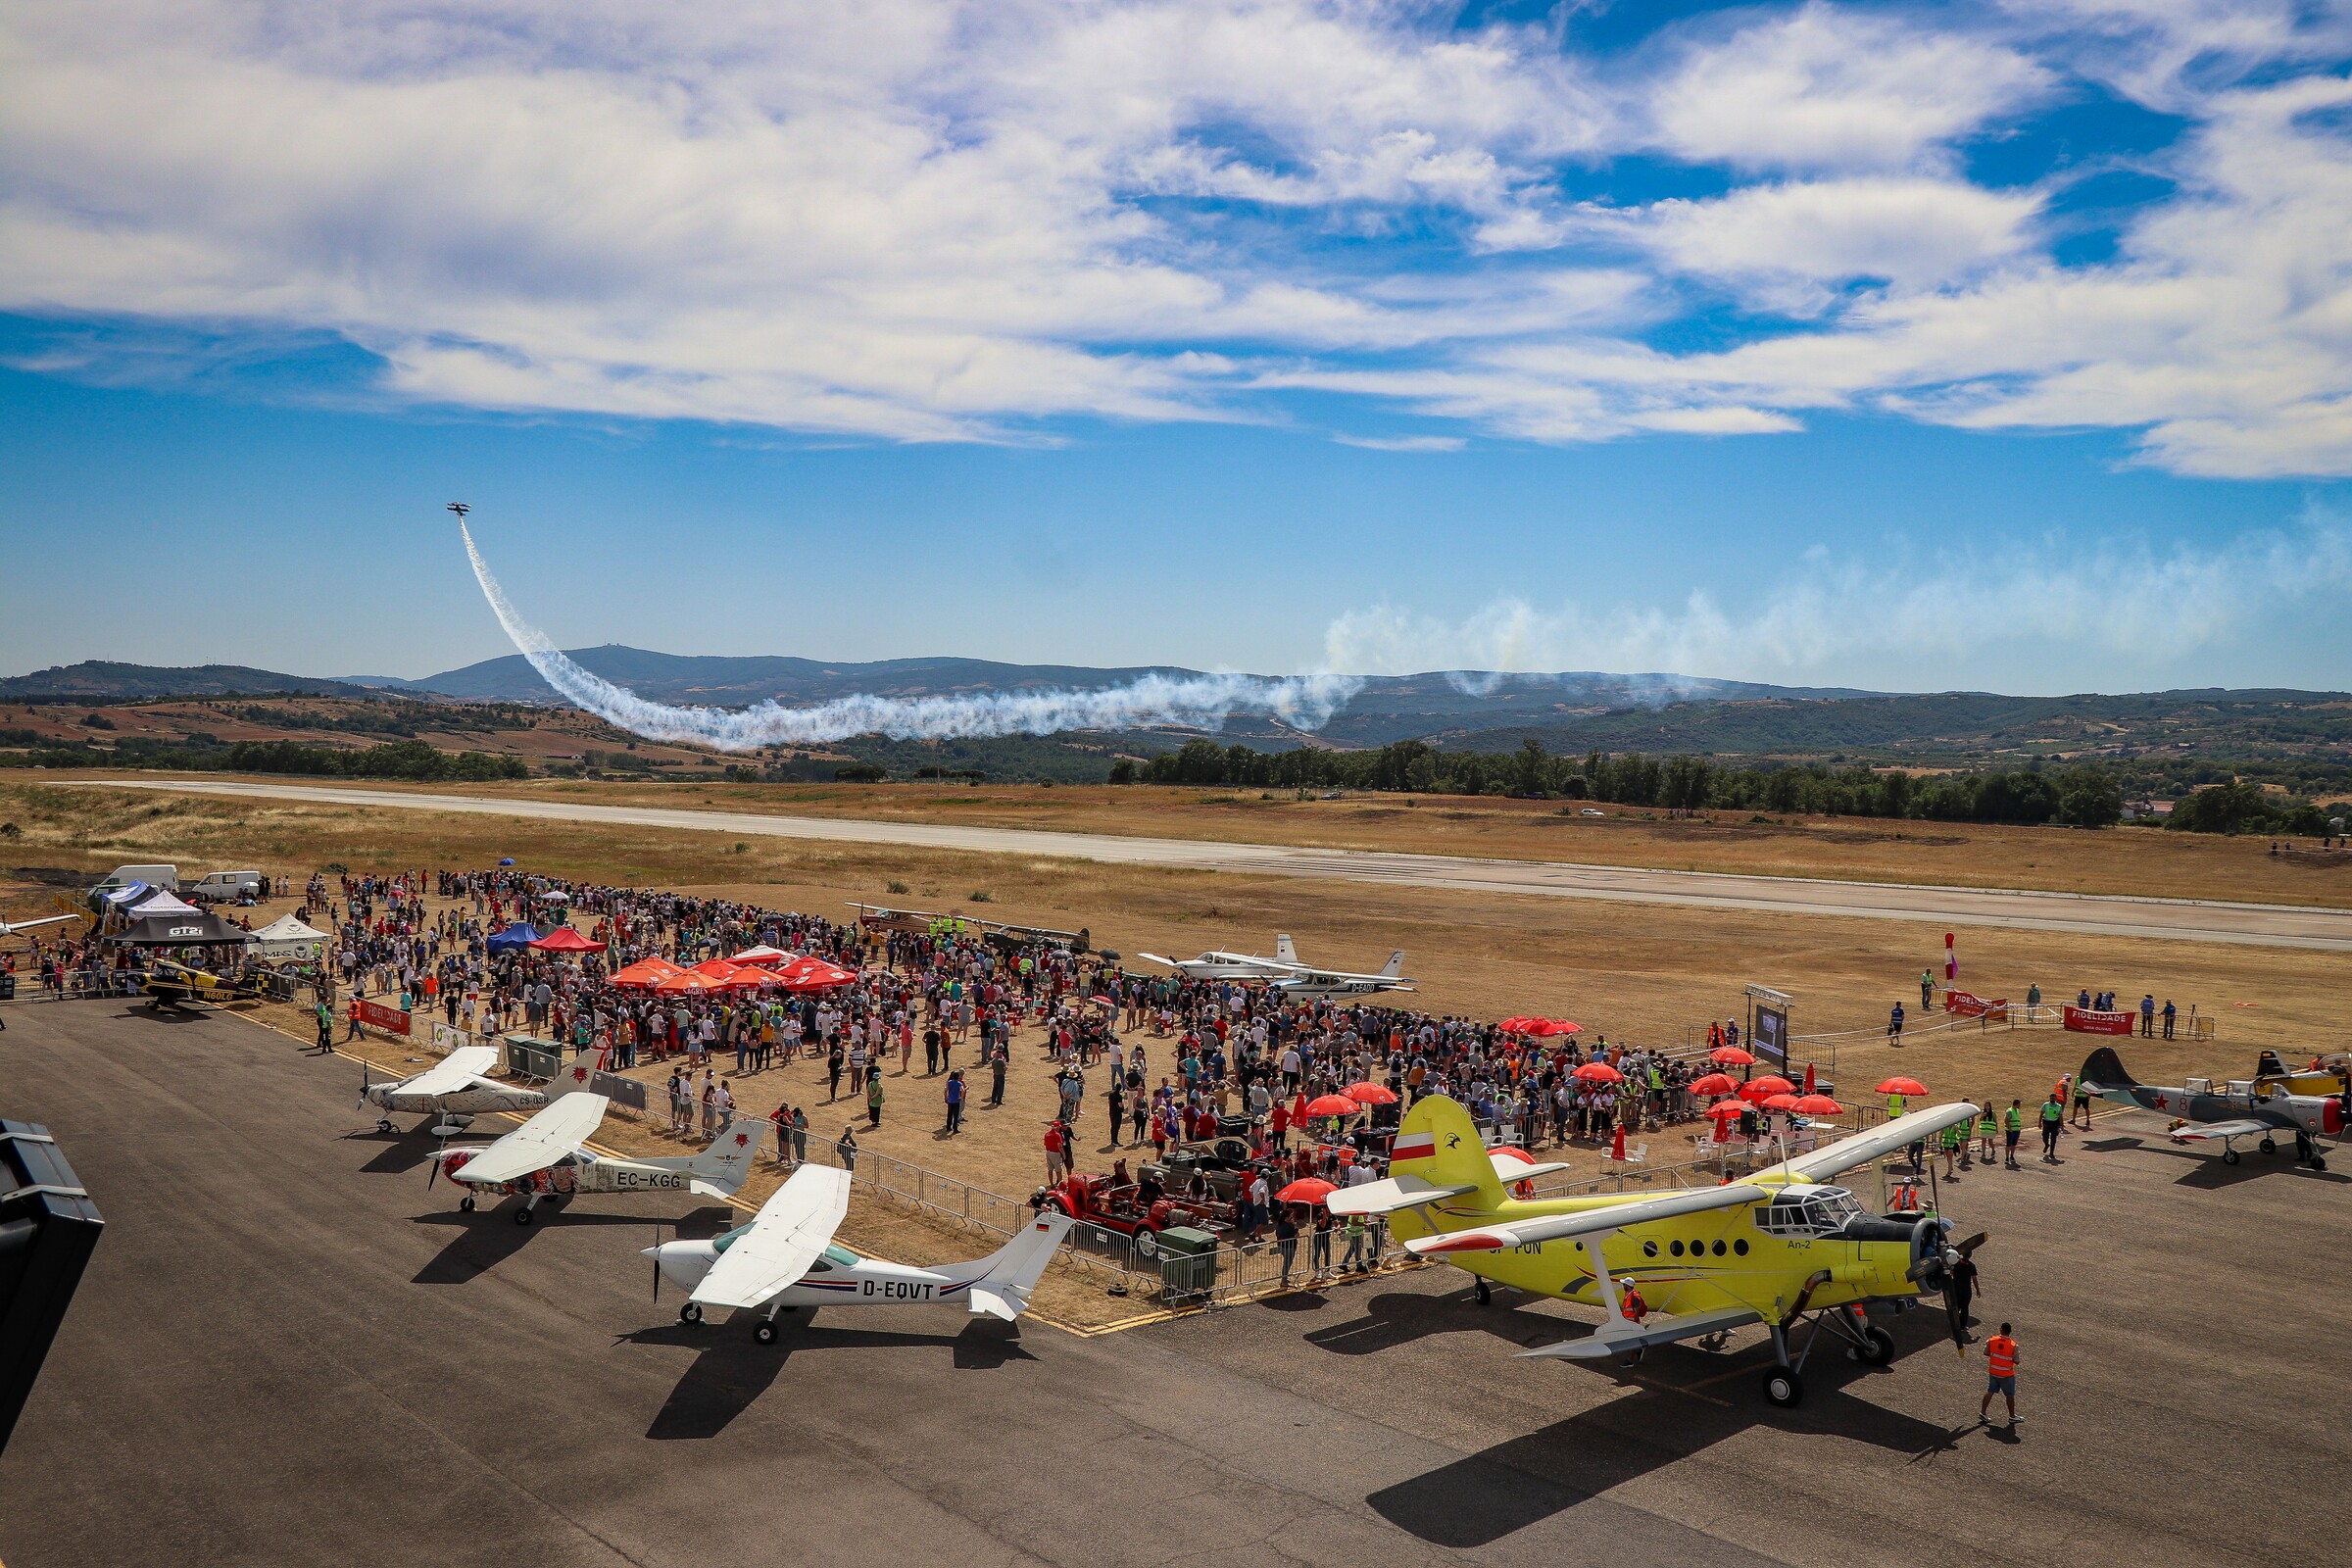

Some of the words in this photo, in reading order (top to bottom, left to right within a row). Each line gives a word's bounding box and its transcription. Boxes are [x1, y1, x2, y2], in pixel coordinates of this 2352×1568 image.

[204, 991, 233, 1001] N60LG
[683, 987, 709, 996] SAGRES
[2179, 1097, 2188, 1111] 8
[617, 1171, 680, 1188] EC-KGG
[1788, 1240, 1811, 1250] An-2
[863, 1280, 934, 1300] D-EQVT
